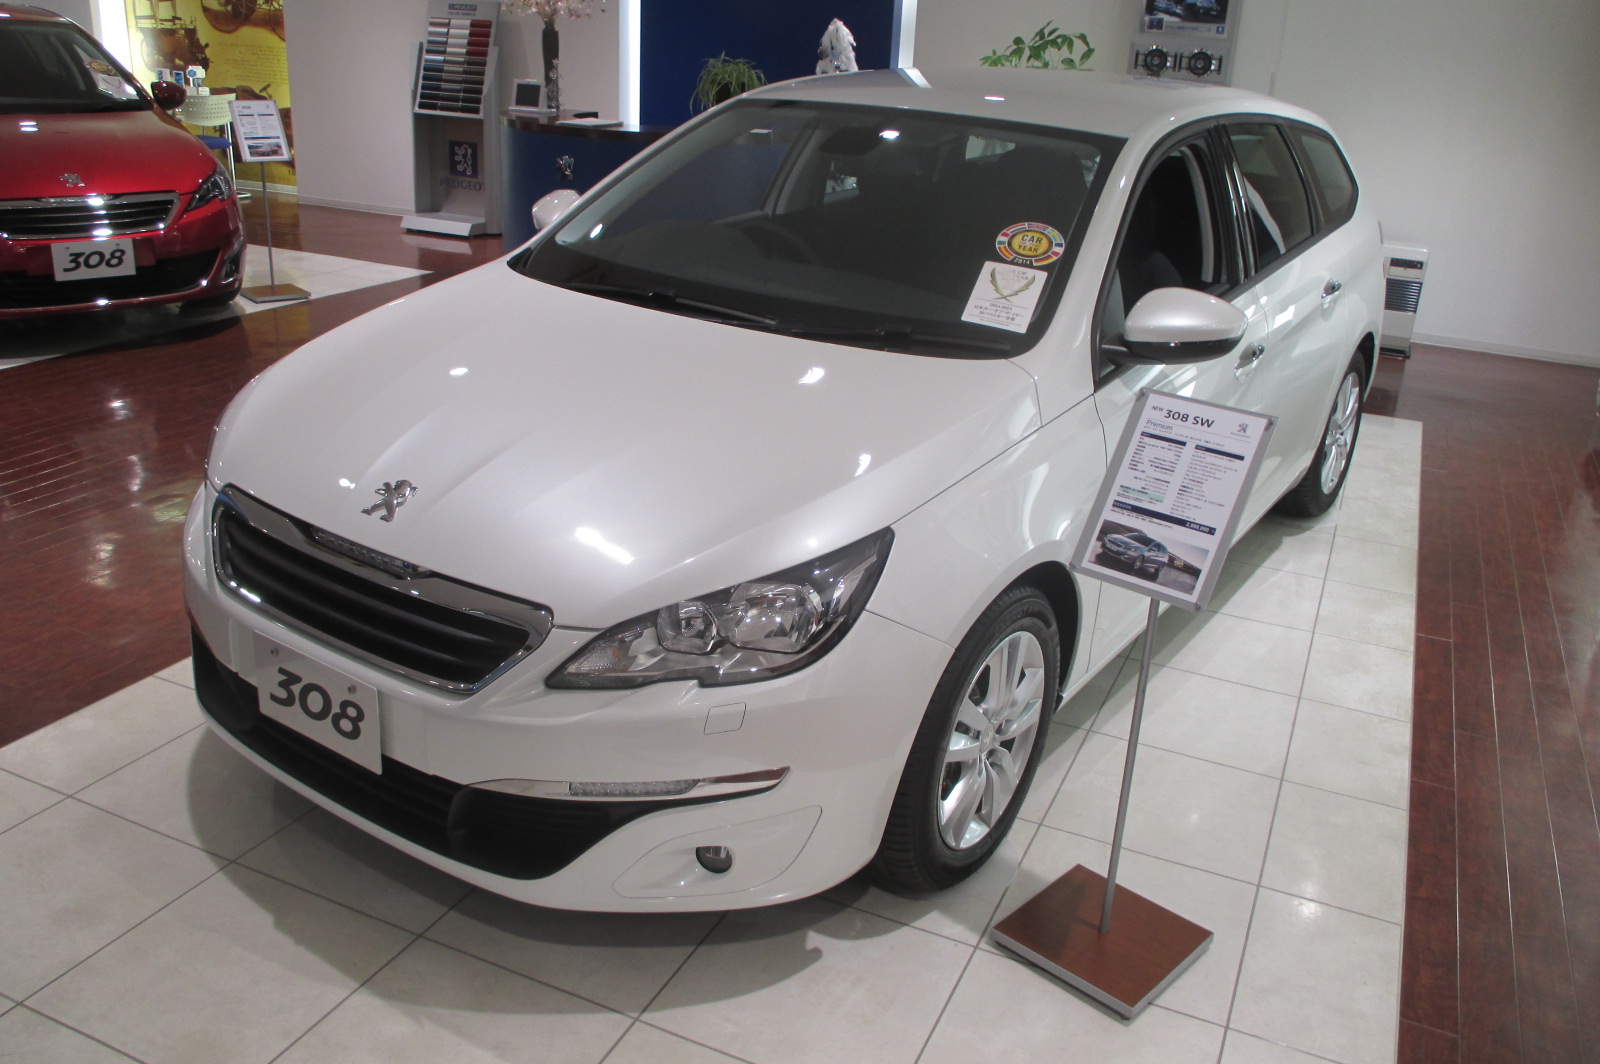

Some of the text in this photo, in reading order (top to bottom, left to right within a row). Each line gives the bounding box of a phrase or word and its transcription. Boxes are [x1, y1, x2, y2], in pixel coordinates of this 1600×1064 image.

[1021, 234, 1043, 244] CAR
[1017, 244, 1039, 253] YEAR
[63, 249, 126, 272] 308
[1146, 419, 1173, 431] Premium
[1164, 409, 1189, 423] 308
[1192, 416, 1215, 428] SW
[270, 666, 366, 740] 308
